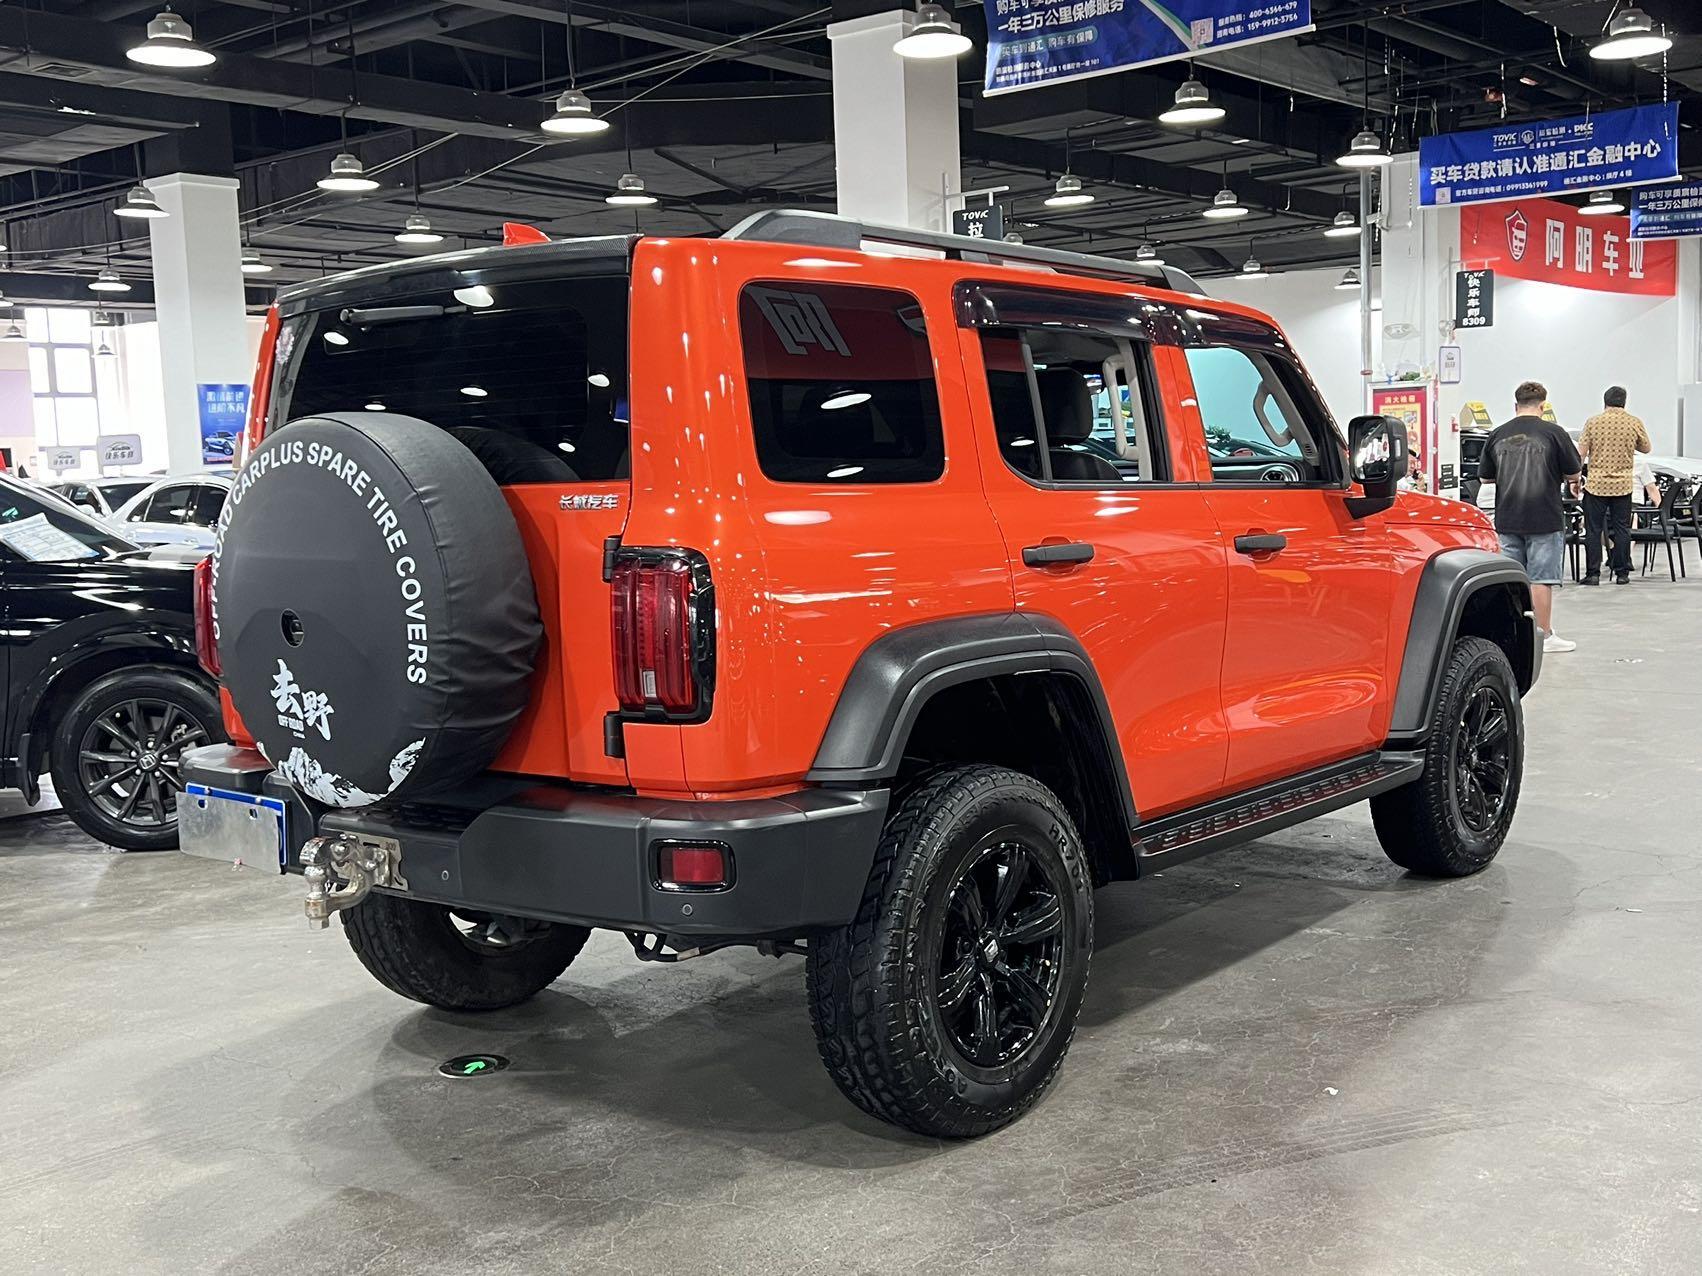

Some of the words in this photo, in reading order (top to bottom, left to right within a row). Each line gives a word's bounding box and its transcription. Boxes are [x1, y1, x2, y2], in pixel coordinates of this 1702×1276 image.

[1430, 139, 1661, 185] 买车贷款请认准通汇金融中心
[1638, 198, 1702, 211] 一年三万公里保
[962, 210, 989, 220] TOVIC
[559, 494, 619, 509] 长城汽车
[232, 441, 304, 505] CARPLUS
[306, 442, 371, 497] SPARE
[366, 487, 408, 554] TIRE
[396, 556, 428, 684] COVERS
